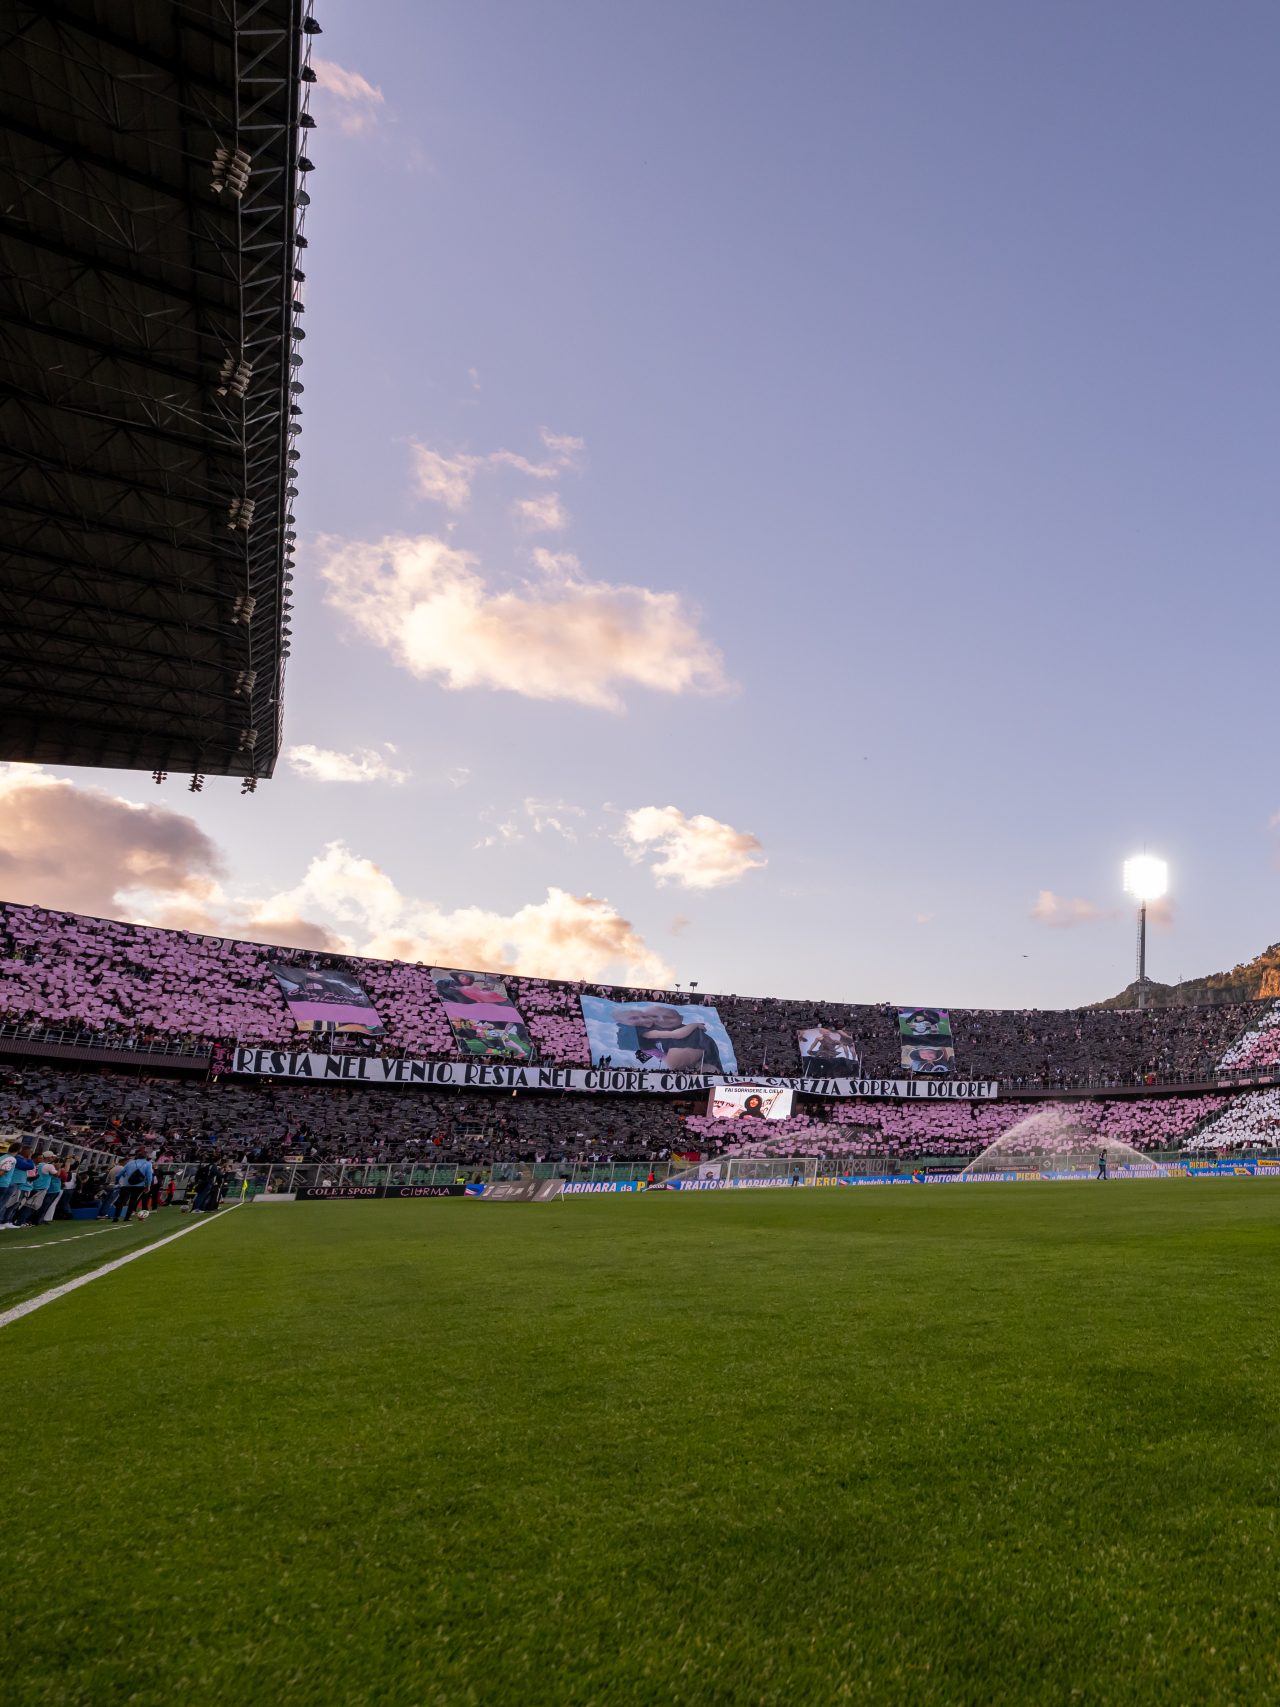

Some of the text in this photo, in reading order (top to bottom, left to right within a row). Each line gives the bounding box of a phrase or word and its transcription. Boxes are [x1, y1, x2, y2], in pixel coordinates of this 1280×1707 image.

[236, 1048, 313, 1077] RESTA
[324, 1055, 370, 1080] NEL
[382, 1058, 456, 1084] VENTO,
[464, 1064, 529, 1087] RESTA
[538, 1067, 577, 1088] NEL
[584, 1070, 655, 1090] CUORE,
[660, 1074, 714, 1090] COME
[766, 1077, 841, 1096] CAREZZA
[849, 1080, 899, 1096] SOPRA
[907, 1081, 921, 1097] IL
[927, 1081, 993, 1098] DOLORE!
[307, 1187, 346, 1197] COLET
[347, 1187, 377, 1196] SPOSI
